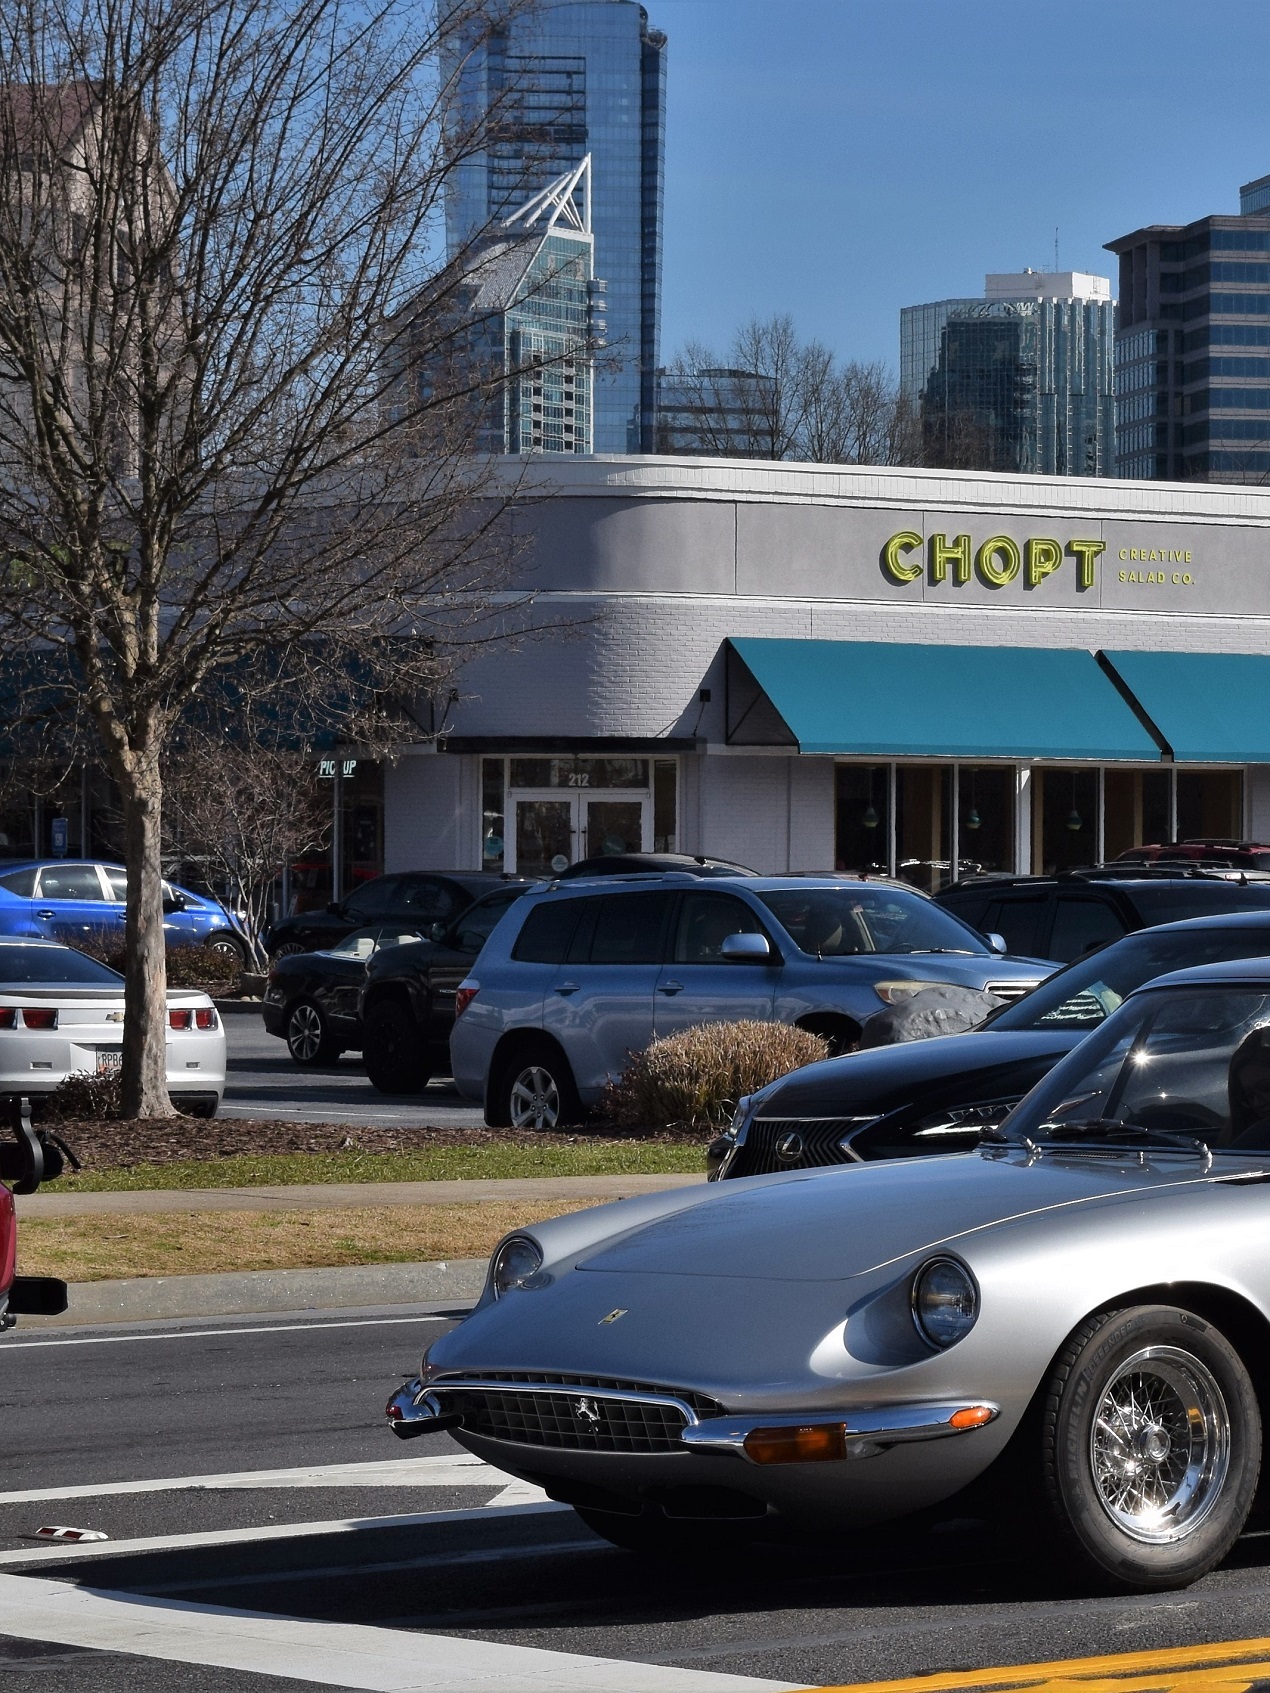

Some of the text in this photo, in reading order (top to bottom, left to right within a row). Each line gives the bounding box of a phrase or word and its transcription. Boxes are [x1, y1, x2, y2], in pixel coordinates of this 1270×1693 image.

[885, 531, 1105, 587] CHOPT
[1118, 549, 1192, 564] CREATIVE
[1118, 570, 1196, 585] SALAD CO.
[319, 760, 357, 776] PIC UP
[568, 773, 590, 786] 212
[1066, 1380, 1090, 1479] MICHELIN
